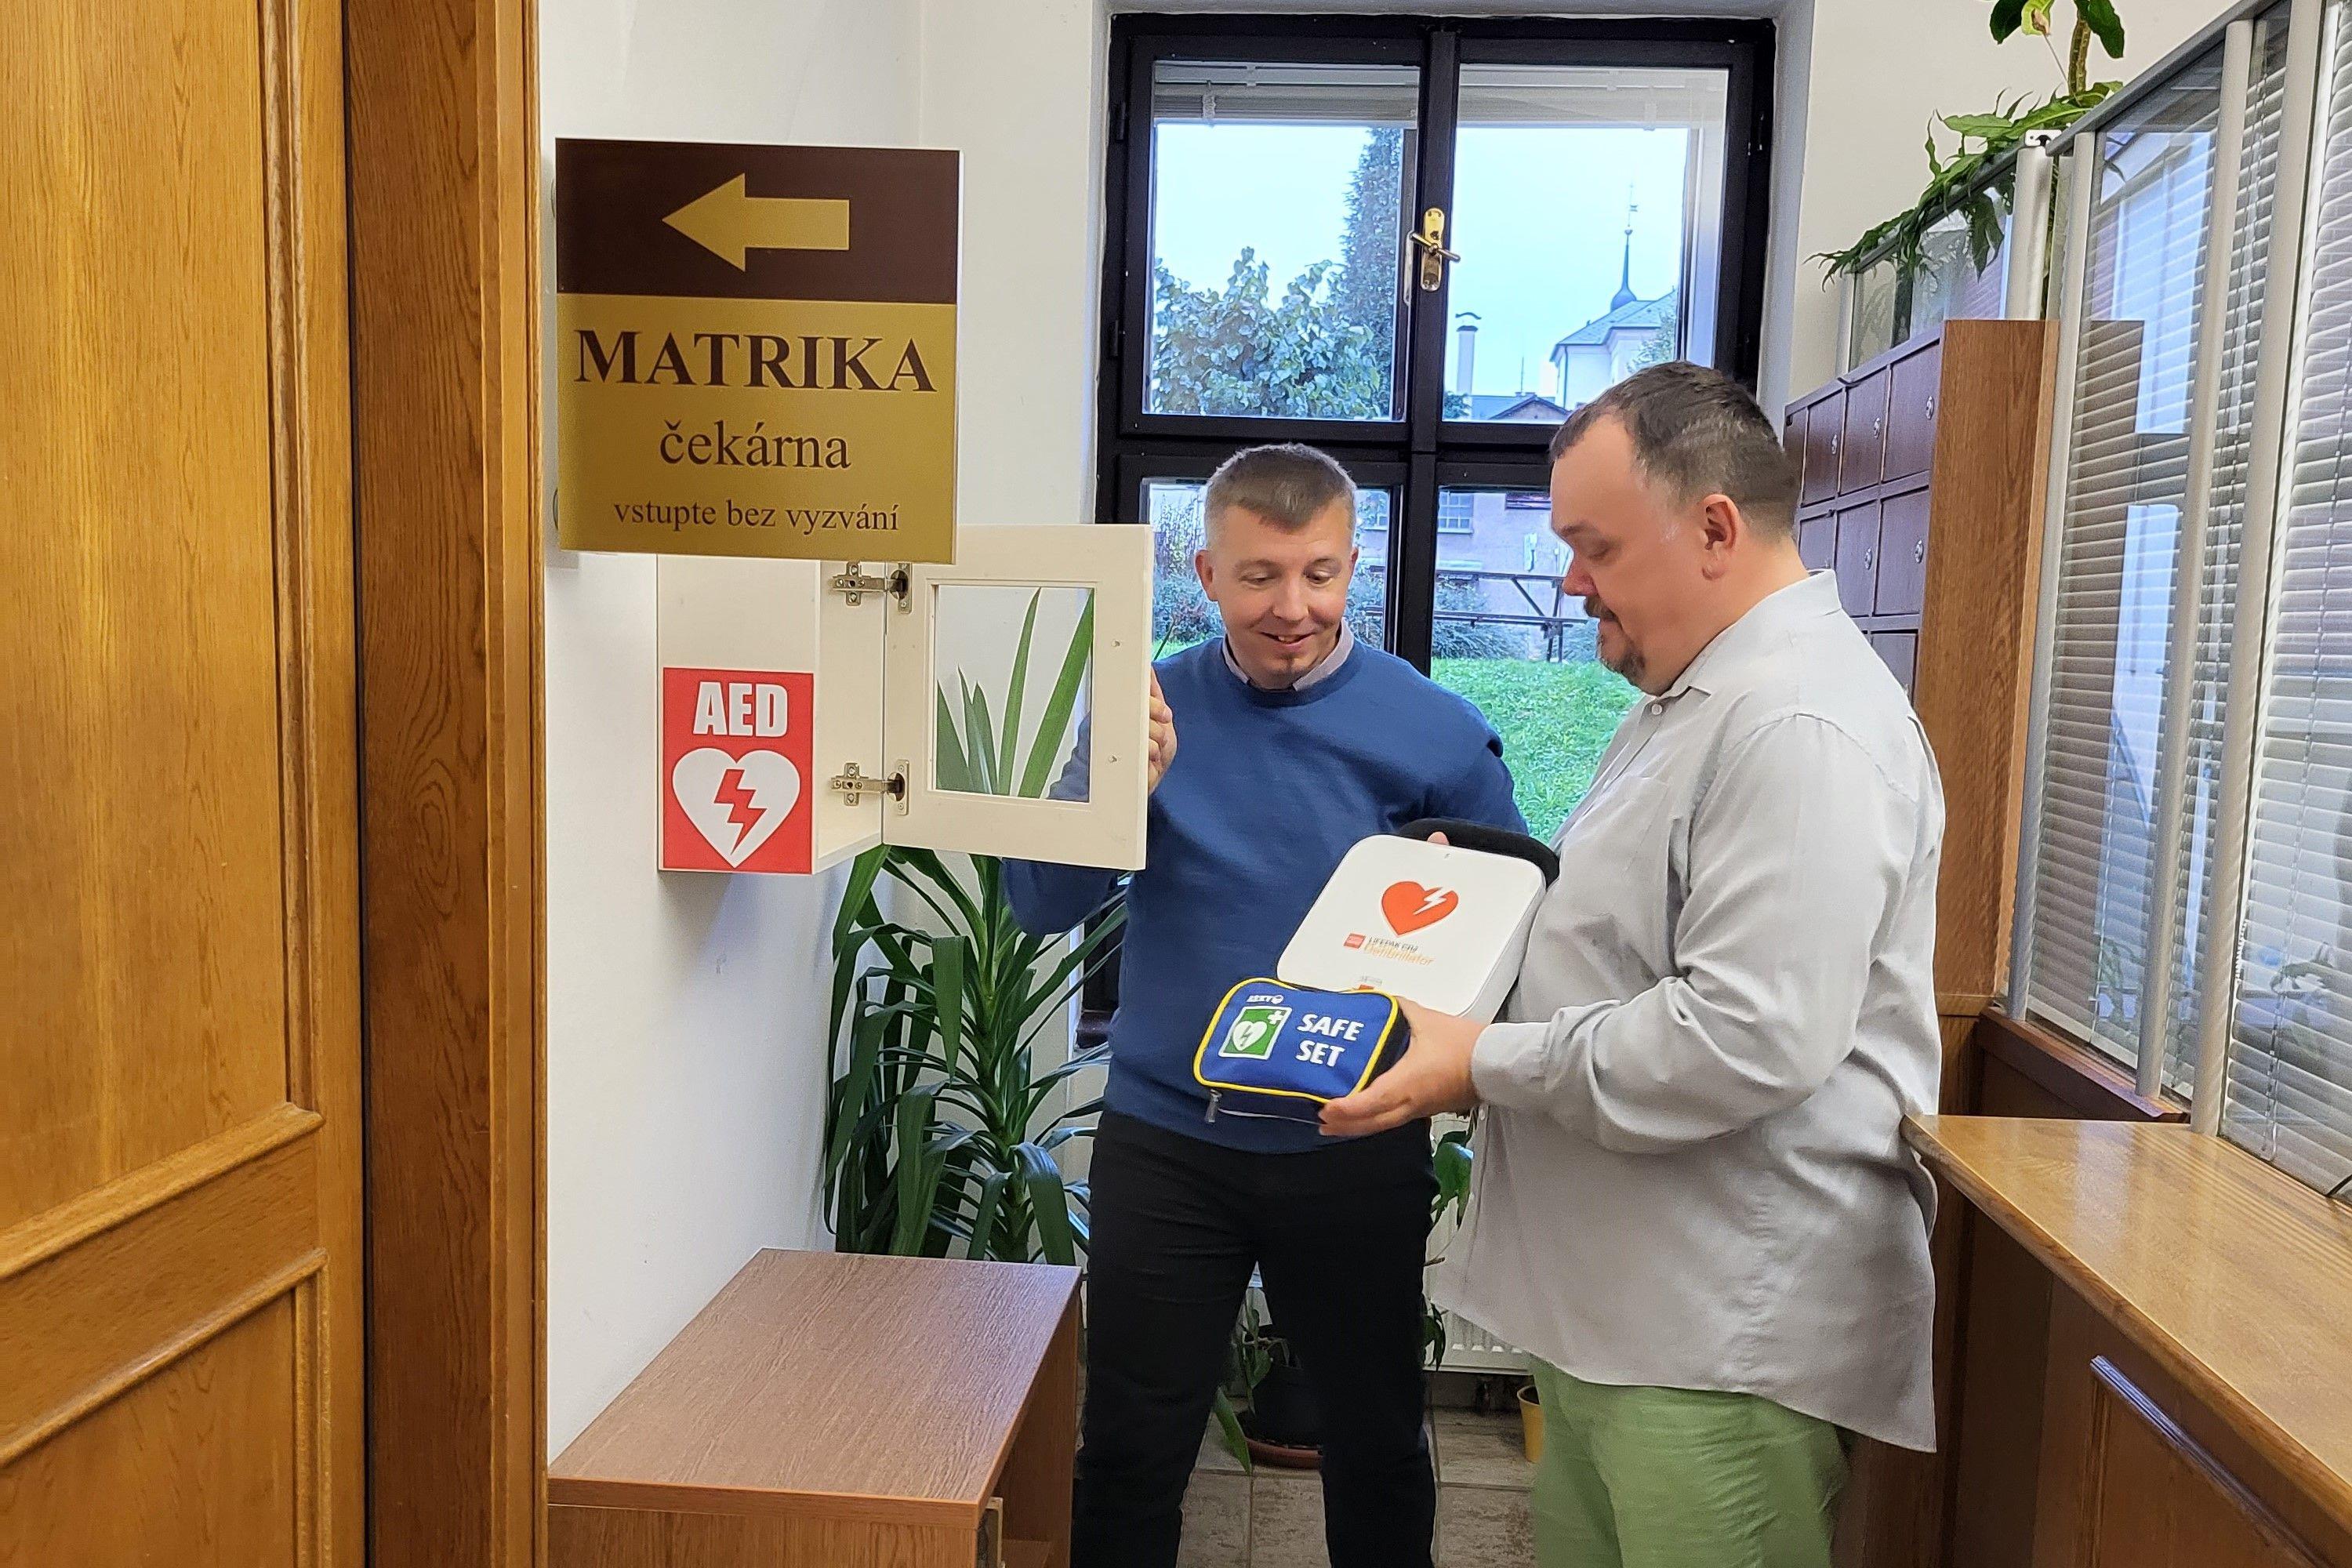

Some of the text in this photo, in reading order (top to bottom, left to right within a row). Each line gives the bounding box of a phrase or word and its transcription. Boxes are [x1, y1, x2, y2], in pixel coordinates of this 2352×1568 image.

[574, 329, 938, 392] MATRIKA
[659, 419, 851, 469] čekárna
[613, 499, 899, 535] vstupte bez vyzvání
[693, 681, 788, 738] AED
[1296, 1013, 1365, 1041] SAFE
[1295, 1040, 1345, 1067] SET
